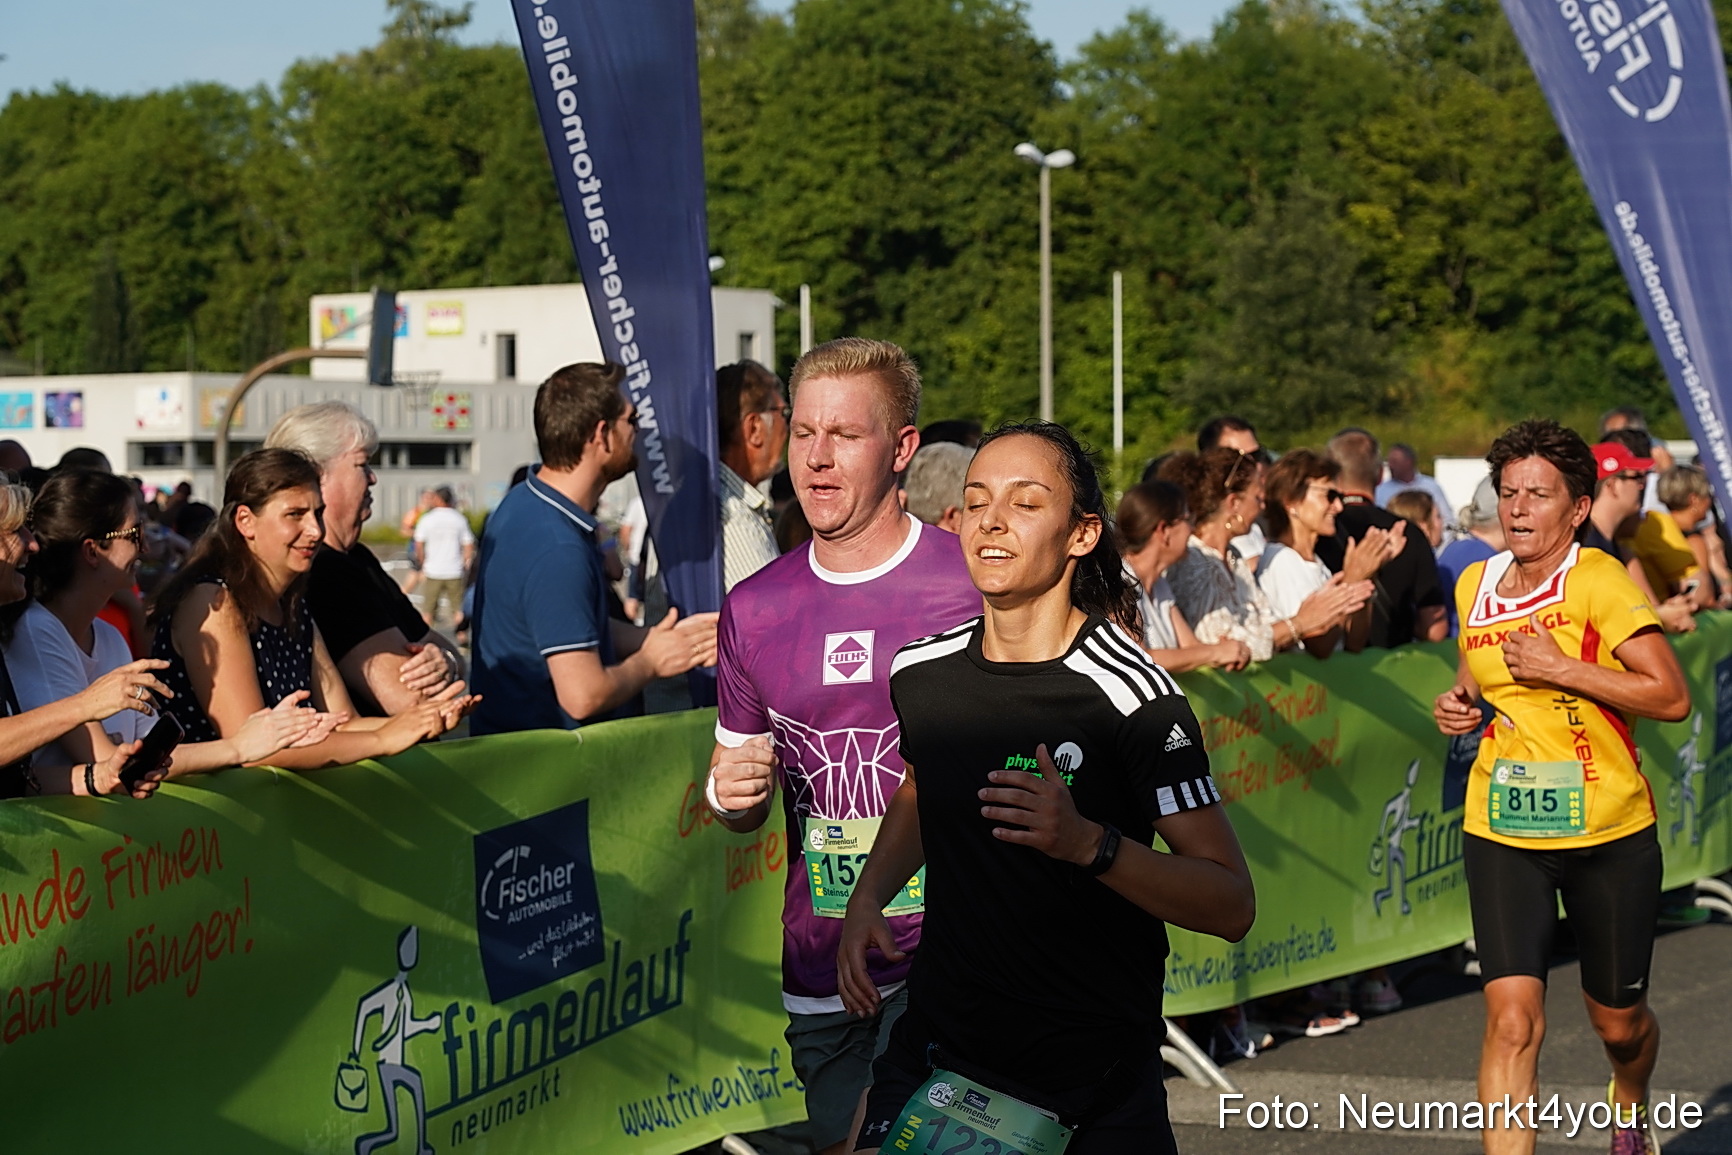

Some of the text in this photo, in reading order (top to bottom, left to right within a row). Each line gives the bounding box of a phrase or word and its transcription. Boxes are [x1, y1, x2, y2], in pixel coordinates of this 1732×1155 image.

[1466, 630, 1510, 651] MAX
[827, 651, 869, 663] FUCHS
[1164, 738, 1192, 752] adidas
[1005, 753, 1040, 771] phys
[1491, 792, 1500, 820] RUN
[1508, 787, 1558, 812] 815
[1568, 791, 1580, 827] 2022
[824, 836, 858, 847] Firmenlauf
[0, 826, 223, 945] nde Firmen
[499, 862, 575, 909] Fischer
[811, 862, 825, 897] RUN
[507, 890, 574, 924] AUTOMOBILE
[127, 877, 254, 998] länger!
[443, 908, 692, 1101] firmenlauf
[451, 1066, 561, 1147] neumarkt
[951, 1100, 1001, 1126] Firmenlauf
[894, 1114, 923, 1151] RUN
[967, 1115, 997, 1131] neumarkt
